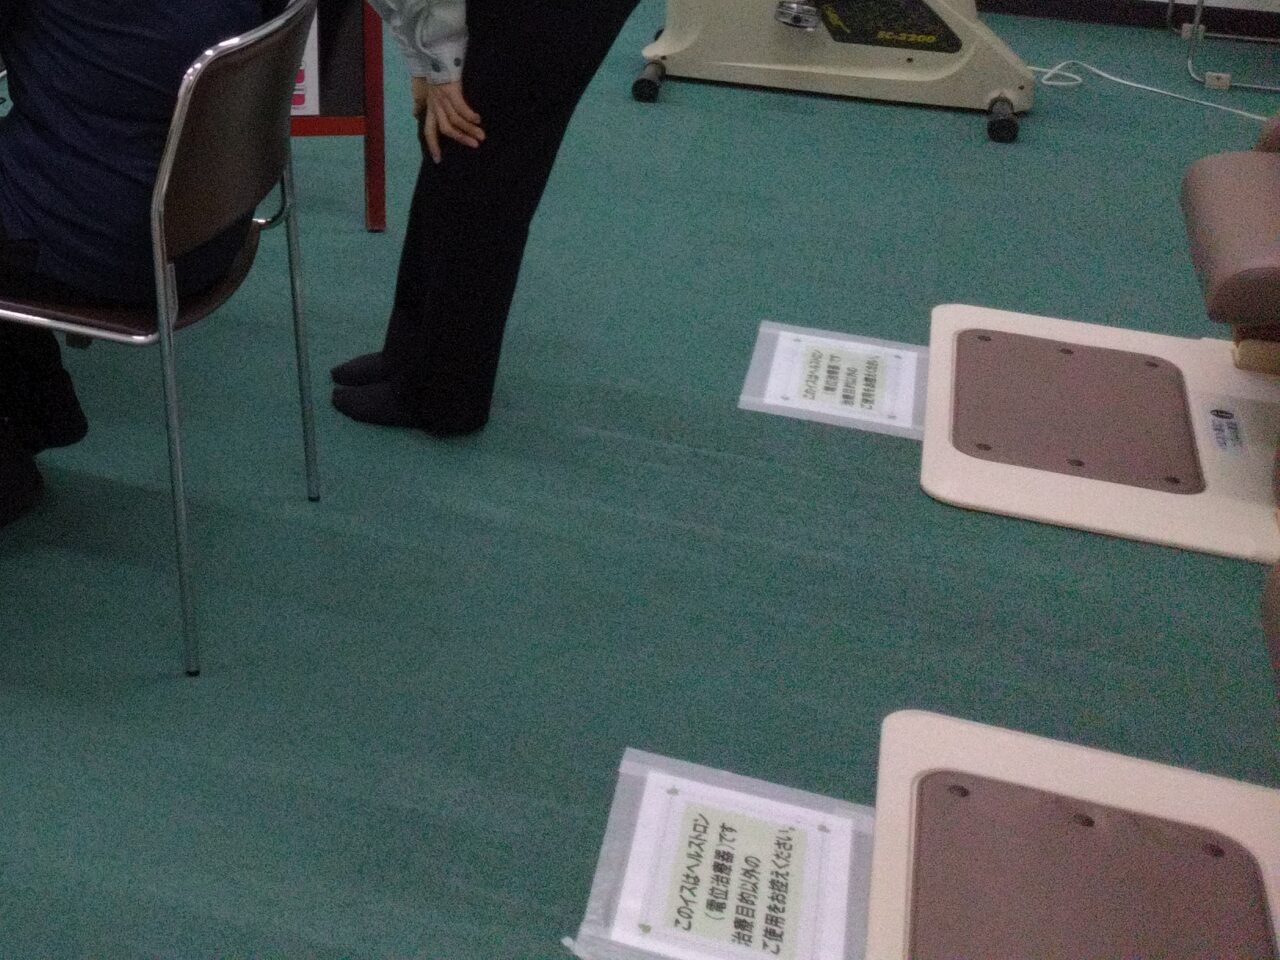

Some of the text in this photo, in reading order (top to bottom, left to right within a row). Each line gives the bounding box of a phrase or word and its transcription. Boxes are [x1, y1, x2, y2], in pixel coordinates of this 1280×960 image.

[674, 812, 710, 931] このイスはヘルストロン
[731, 855, 761, 947] 治療目的以外の
[761, 826, 796, 955] ご使用をお控えください。
